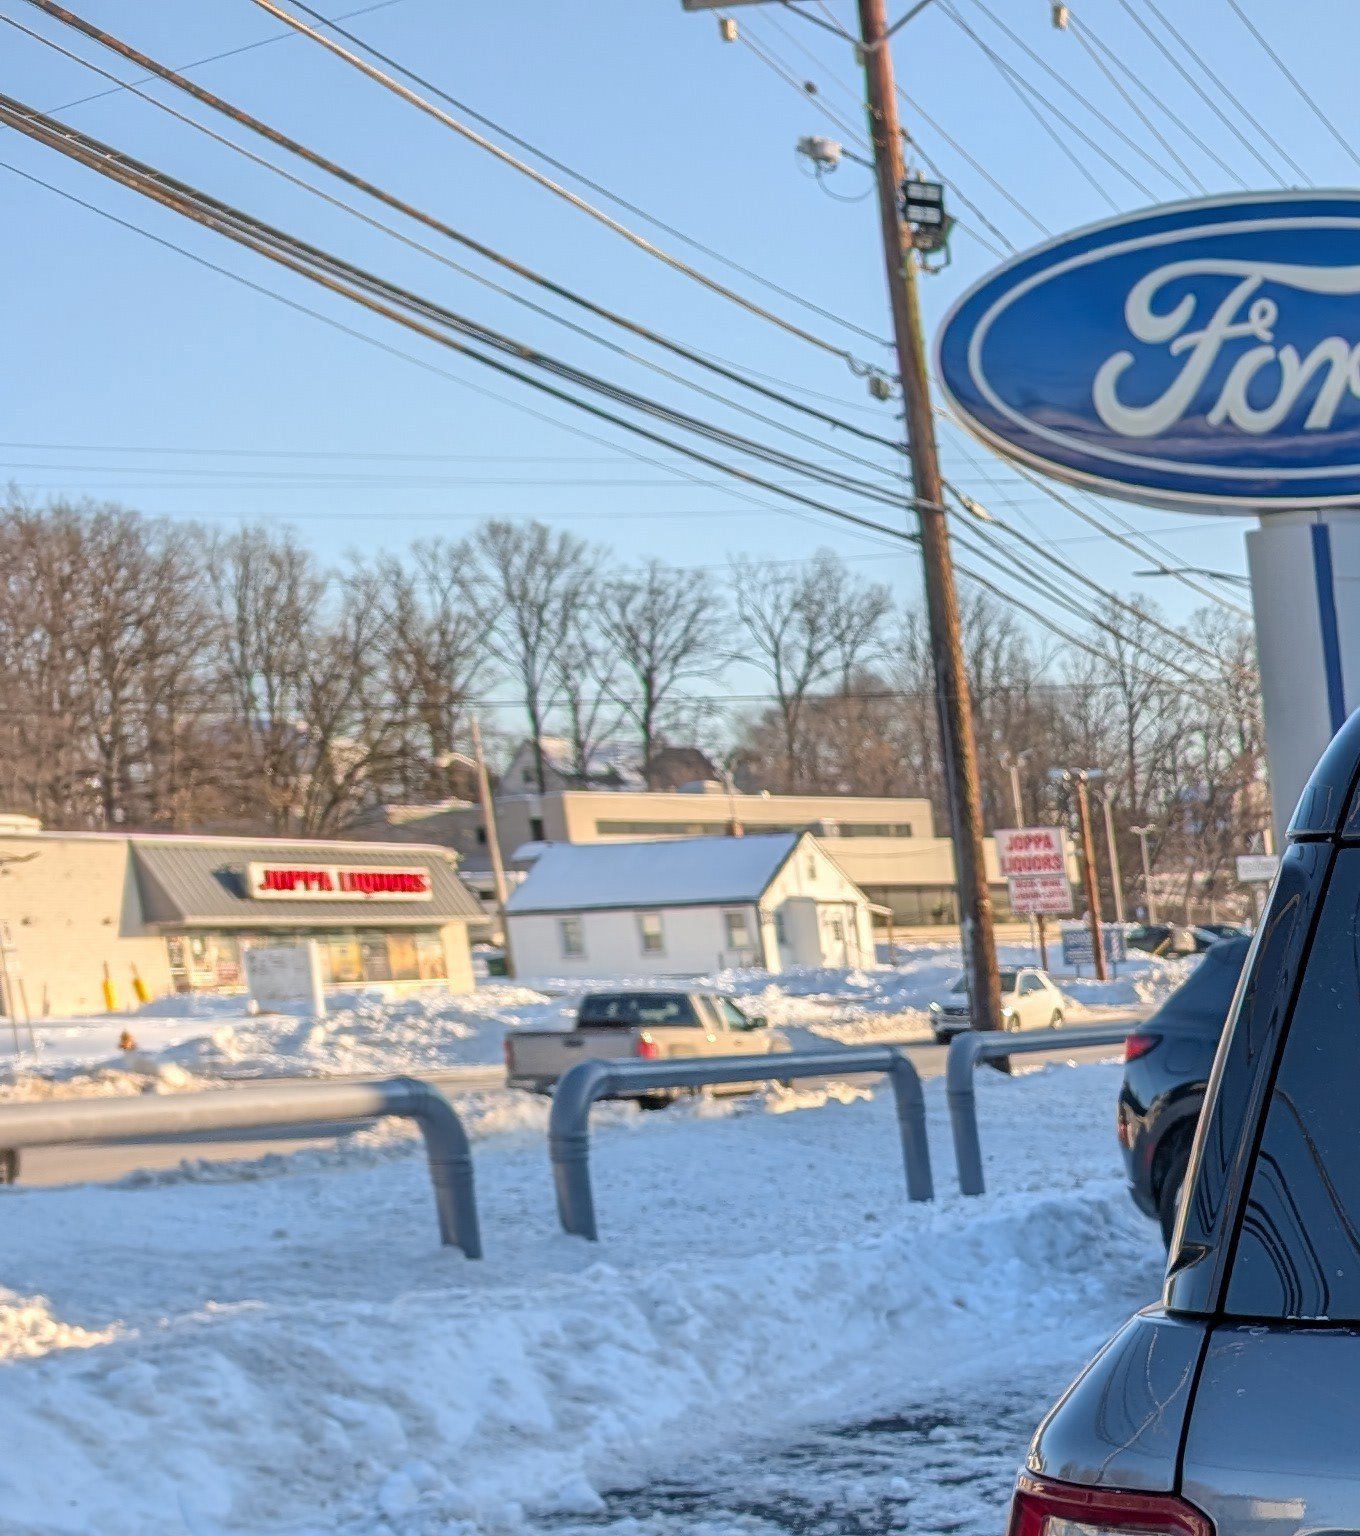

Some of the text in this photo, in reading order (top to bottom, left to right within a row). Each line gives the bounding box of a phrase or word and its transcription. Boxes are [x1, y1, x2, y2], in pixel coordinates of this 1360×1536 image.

[1006, 832, 1054, 851] JOPPA
[1000, 854, 1063, 873] LIQUORS
[258, 870, 428, 895] JOPPA LIQUORS
